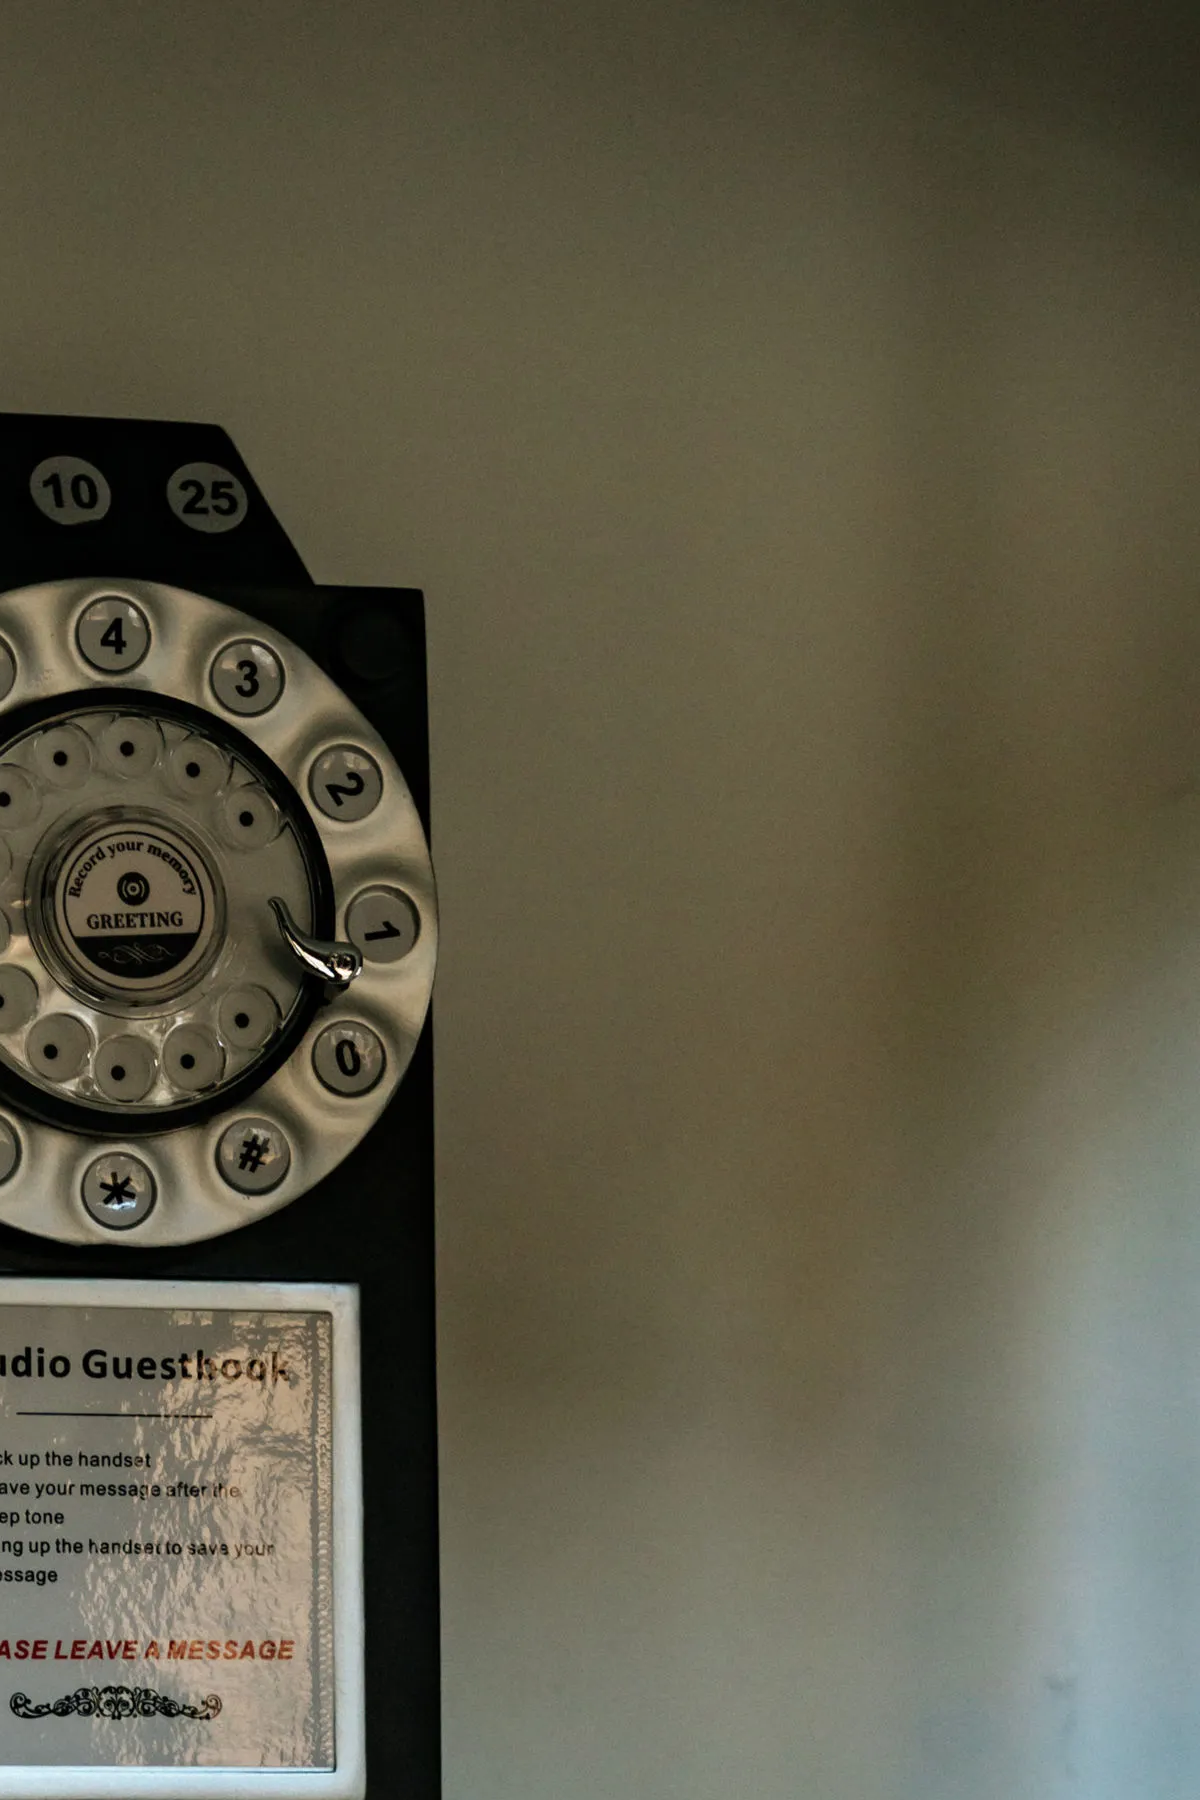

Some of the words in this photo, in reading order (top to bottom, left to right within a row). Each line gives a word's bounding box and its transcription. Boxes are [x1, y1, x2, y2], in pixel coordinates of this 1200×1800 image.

[41, 472, 98, 509] 10
[178, 479, 240, 516] 25
[100, 617, 127, 654] 4
[234, 660, 260, 697] 3
[326, 772, 365, 805] 2
[68, 846, 107, 898] Record
[107, 840, 144, 858] your
[147, 843, 197, 896] memory
[86, 911, 184, 930] GREETING
[363, 921, 400, 943] 1
[336, 1039, 361, 1076] 0
[239, 1134, 270, 1171] #
[82, 1349, 291, 1383] Guestbook
[19, 1454, 40, 1471] up
[45, 1452, 73, 1466] the
[78, 1452, 151, 1468] handset
[35, 1483, 75, 1499] your
[80, 1484, 160, 1500] message
[166, 1483, 206, 1497] after
[212, 1483, 240, 1497] the
[25, 1510, 64, 1525] tone
[29, 1542, 50, 1557] up
[55, 1539, 83, 1554] the
[89, 1540, 161, 1555] handset
[165, 1542, 182, 1555] to
[187, 1543, 229, 1556] save
[234, 1543, 274, 1559] your
[54, 1640, 138, 1660] LEAVE
[144, 1641, 159, 1659] A
[167, 1640, 295, 1660] MESSAGE
